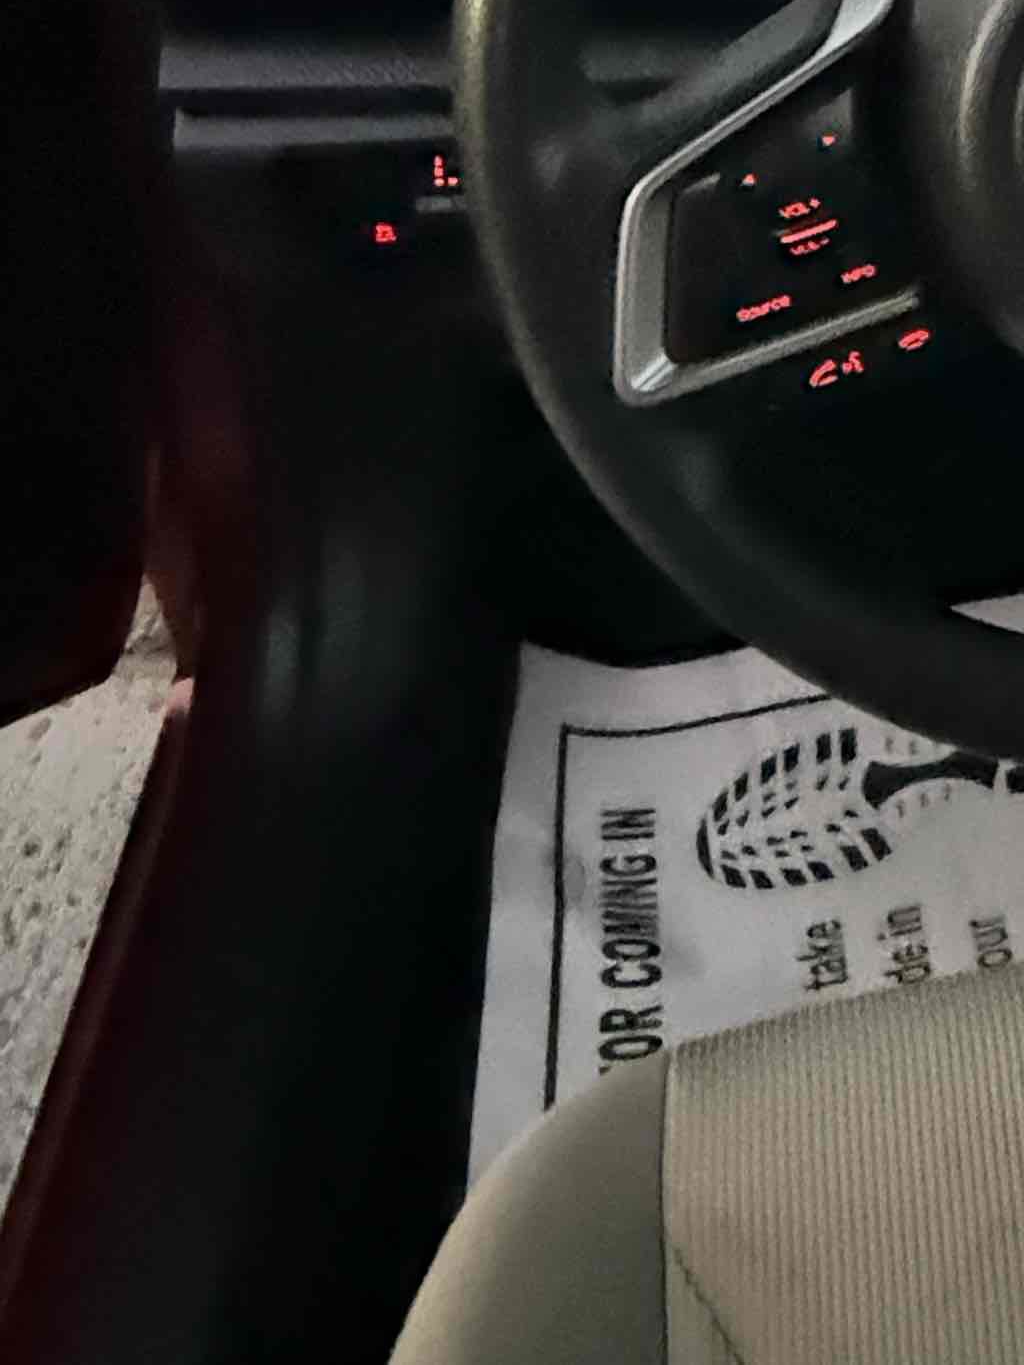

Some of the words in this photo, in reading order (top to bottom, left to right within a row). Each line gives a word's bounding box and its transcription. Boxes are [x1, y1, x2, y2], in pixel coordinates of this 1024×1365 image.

[600, 808, 656, 841] IN
[599, 854, 662, 989] COMING
[796, 918, 849, 992] take
[876, 903, 923, 937] in
[597, 1004, 663, 1074] OR
